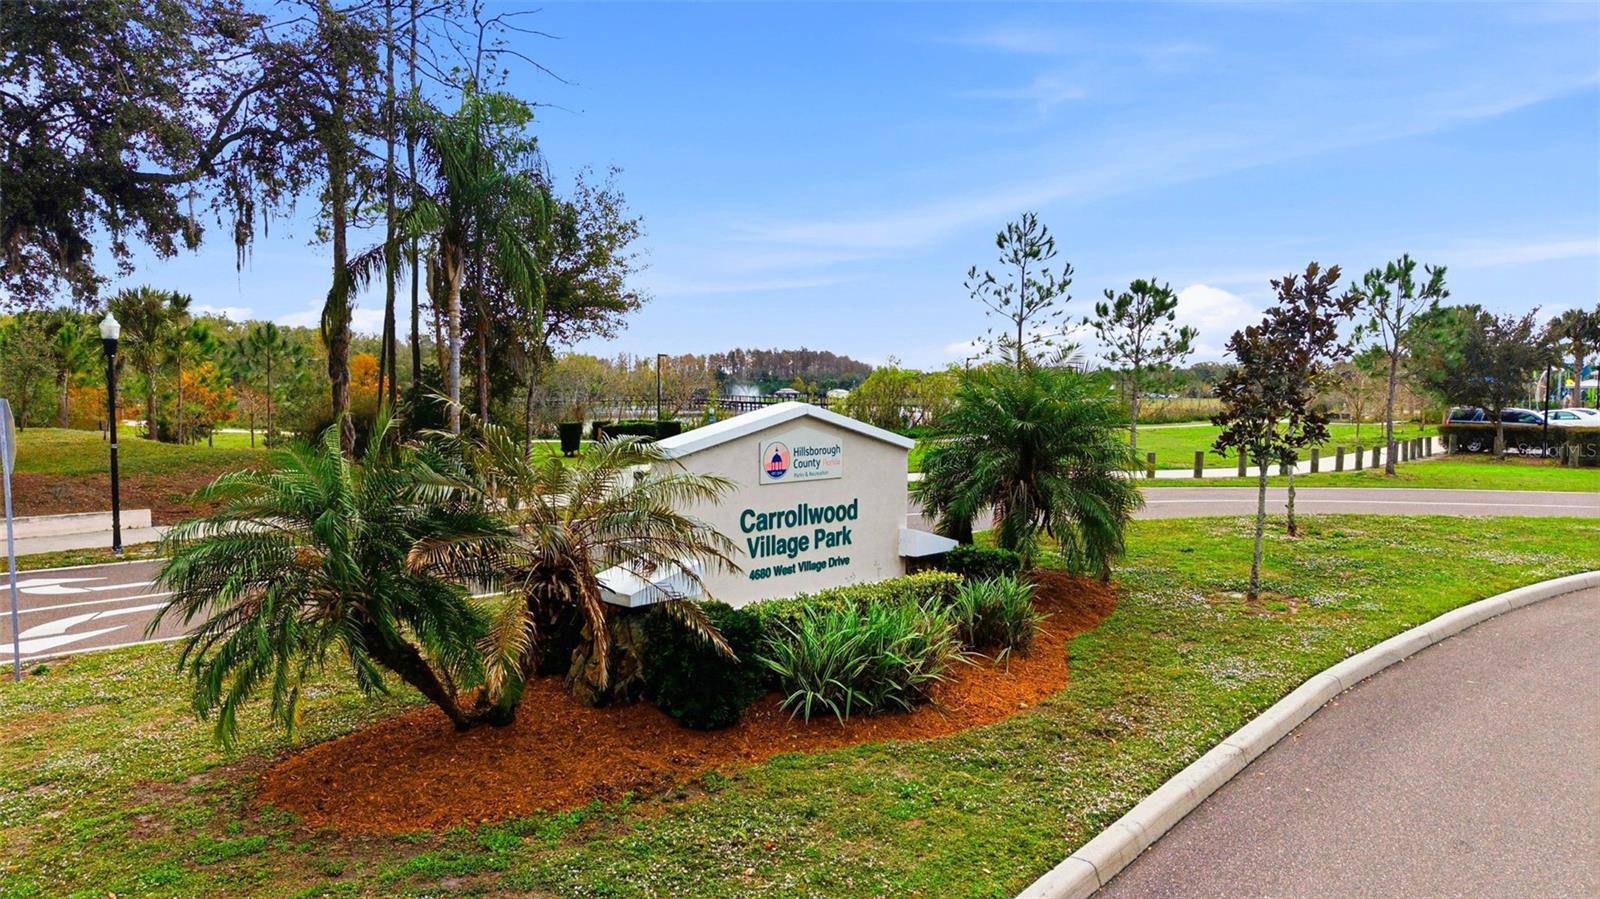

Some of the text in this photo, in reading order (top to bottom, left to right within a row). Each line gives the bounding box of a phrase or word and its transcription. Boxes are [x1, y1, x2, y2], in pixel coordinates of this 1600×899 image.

[793, 444, 841, 457] Hillsborough
[793, 458, 821, 470] County
[740, 497, 858, 533] Carrollwood
[747, 525, 852, 559] Village Park
[749, 556, 850, 580] 4680 West Village Drive
